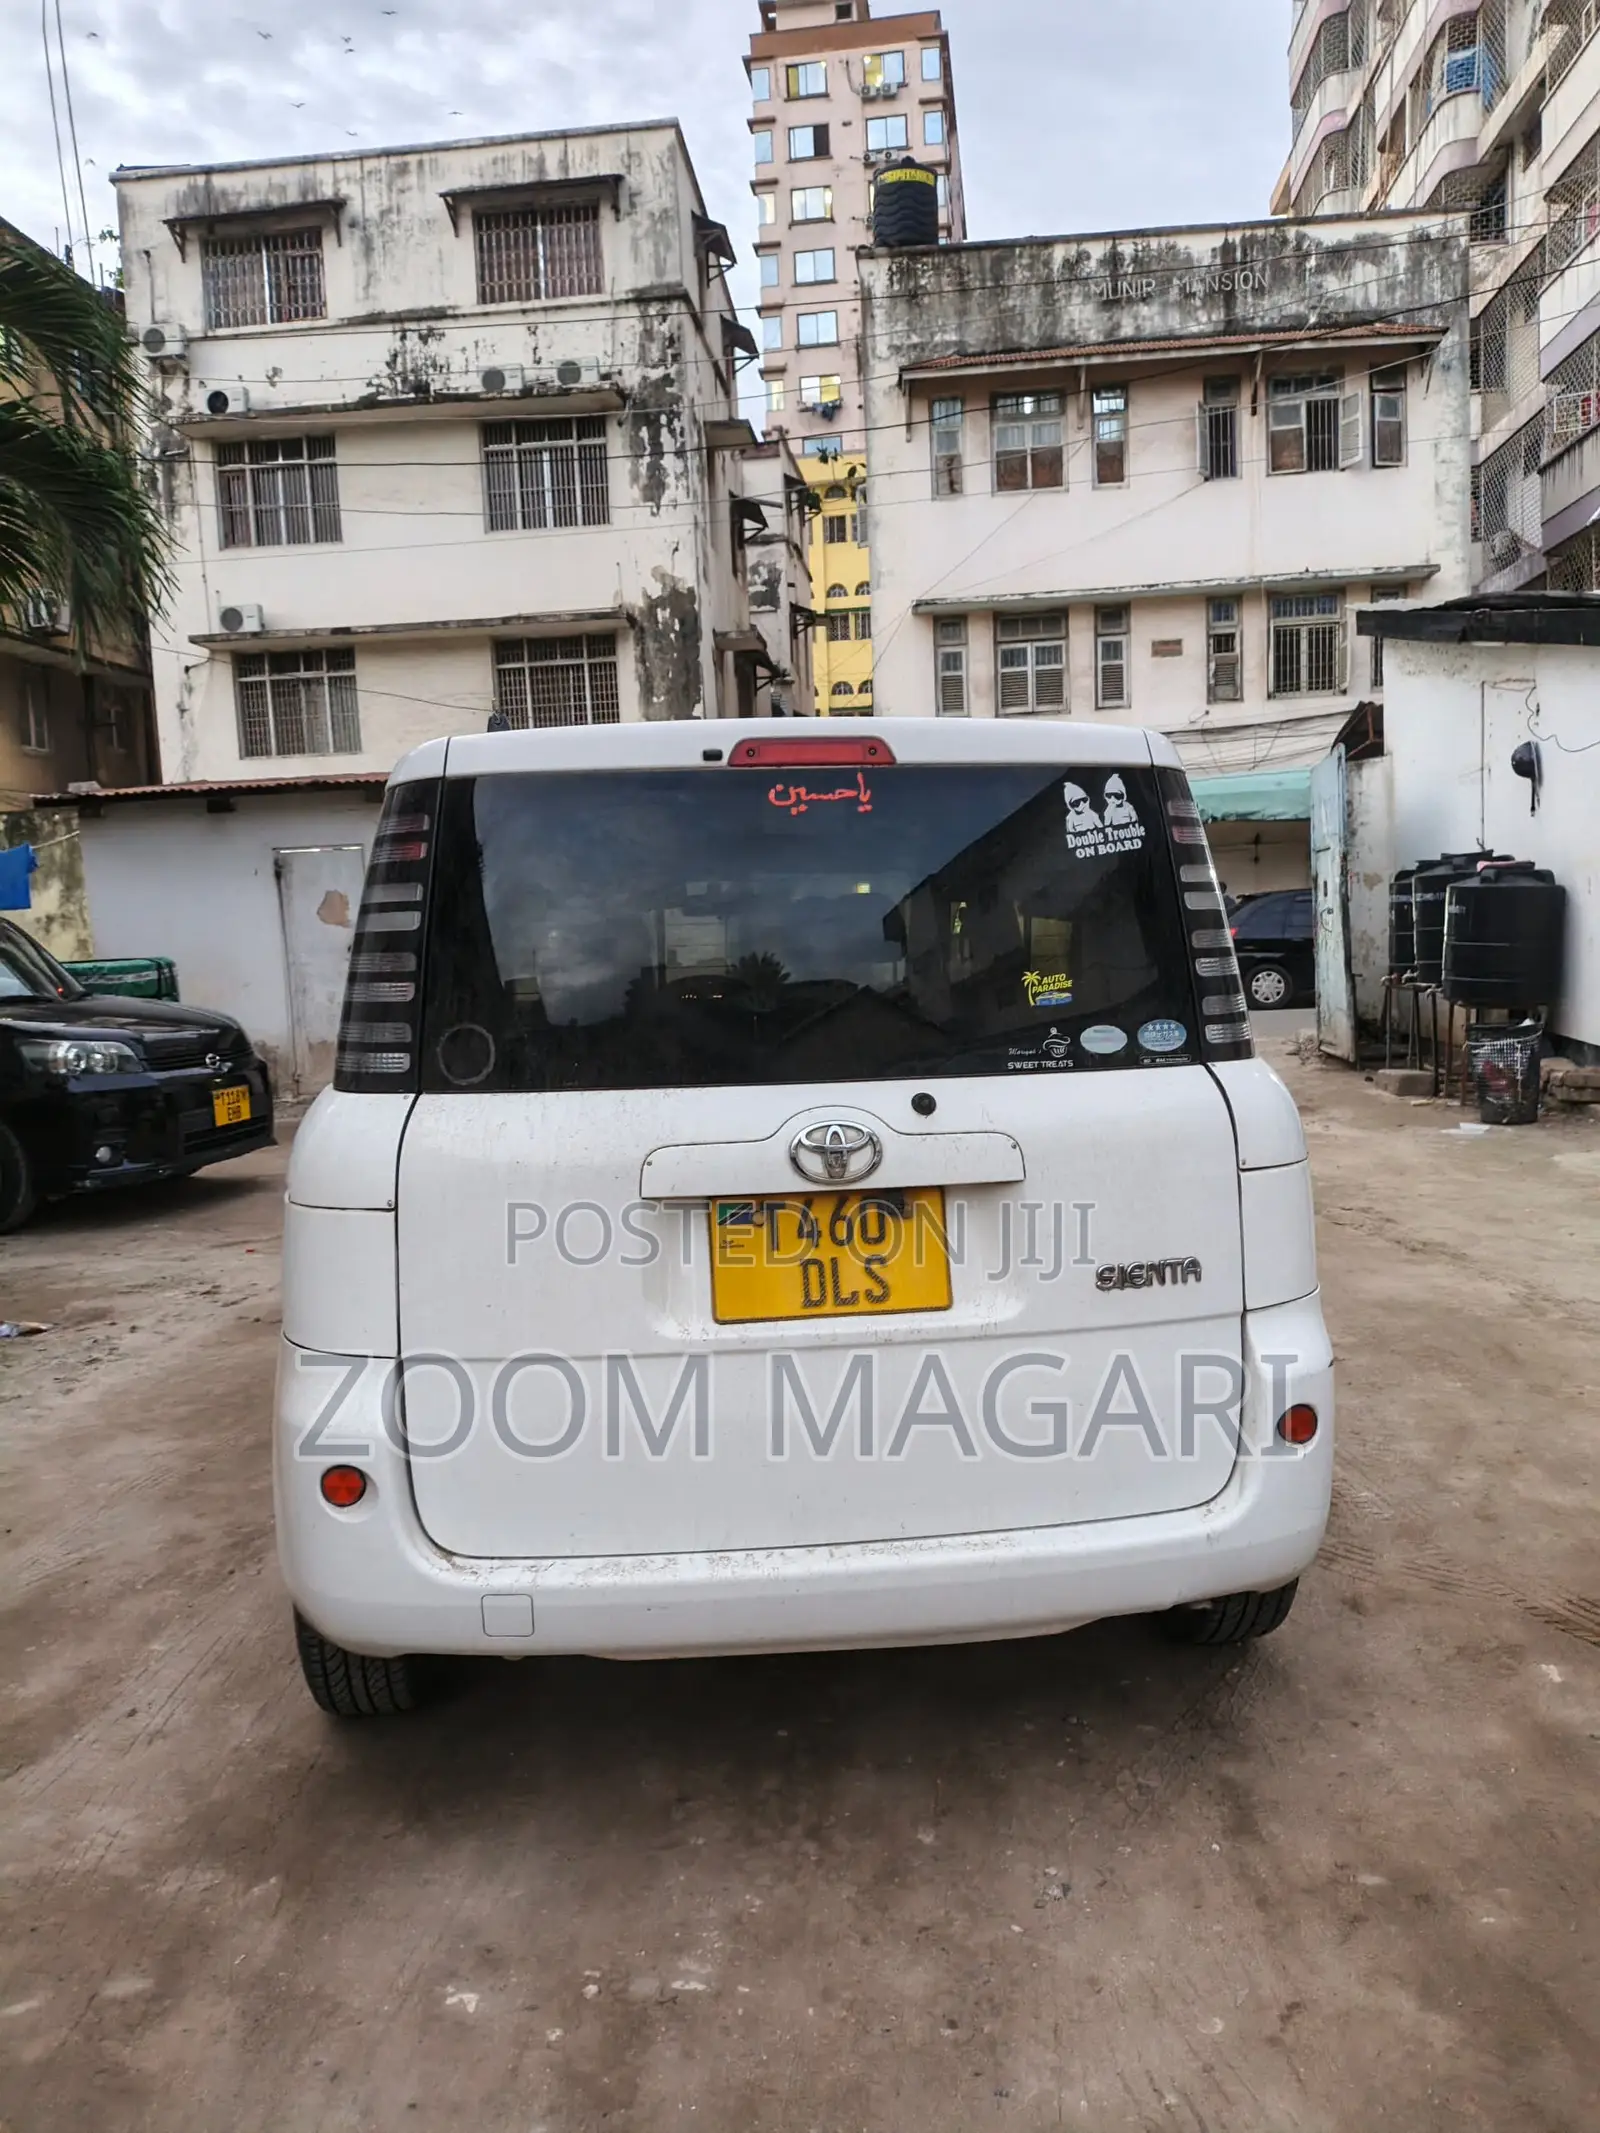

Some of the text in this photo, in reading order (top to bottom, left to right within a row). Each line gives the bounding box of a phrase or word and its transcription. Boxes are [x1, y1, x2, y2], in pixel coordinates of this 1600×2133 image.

[1090, 278, 1156, 300] MUNIR
[1066, 823, 1145, 848] Double Trouble
[1075, 838, 1142, 858] ON BOARD
[1032, 980, 1073, 993] PARADISE
[1042, 973, 1066, 984] AUTO
[1007, 1060, 1074, 1069] SWEET TREATS
[801, 1255, 890, 1308] DLS
[1096, 1256, 1202, 1291] SIENTA
